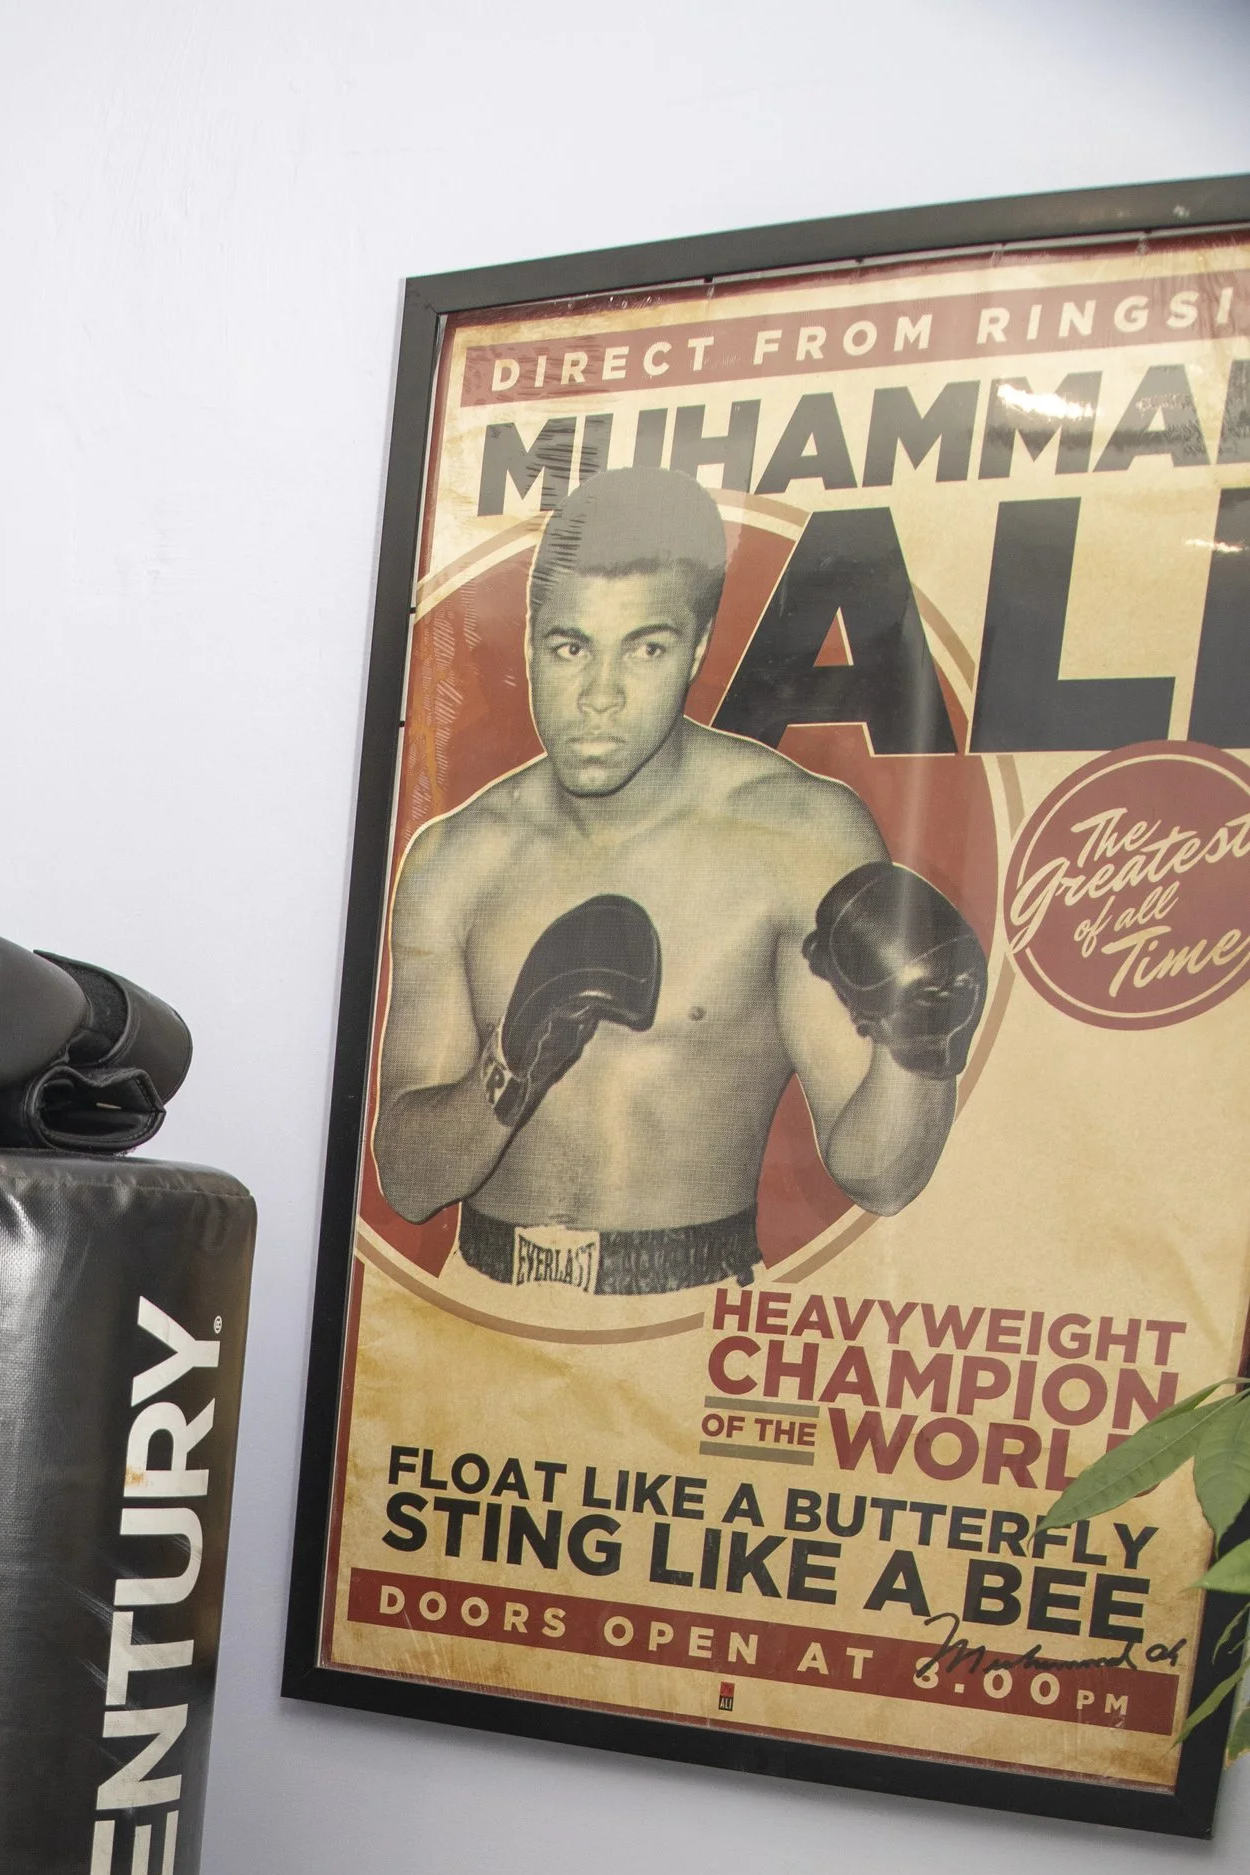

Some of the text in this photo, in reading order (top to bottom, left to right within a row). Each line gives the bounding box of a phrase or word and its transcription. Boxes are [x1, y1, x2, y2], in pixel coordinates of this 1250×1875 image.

[491, 286, 1234, 392] DIRECT FROM RINGSI
[1070, 807, 1162, 868] The
[1007, 811, 1250, 956] Greatest
[1073, 880, 1180, 958] of all
[1101, 925, 1250, 998] Time
[516, 1234, 595, 1293] EVERLAST
[712, 1287, 1188, 1367] HEAVYWEIGHT
[708, 1335, 1180, 1431] CHAMPION
[701, 1413, 817, 1447] OF THE
[828, 1407, 1157, 1498] WORL
[388, 1445, 1160, 1570] FLOAT LIKE A BUTTERFLY
[381, 1491, 1151, 1643] STING LIKE A BEE
[379, 1585, 566, 1638] DOORS
[603, 1616, 759, 1664] OPEN
[796, 1642, 873, 1680] AT
[1076, 1689, 1129, 1716] PM
[720, 1697, 733, 1709] ALI
